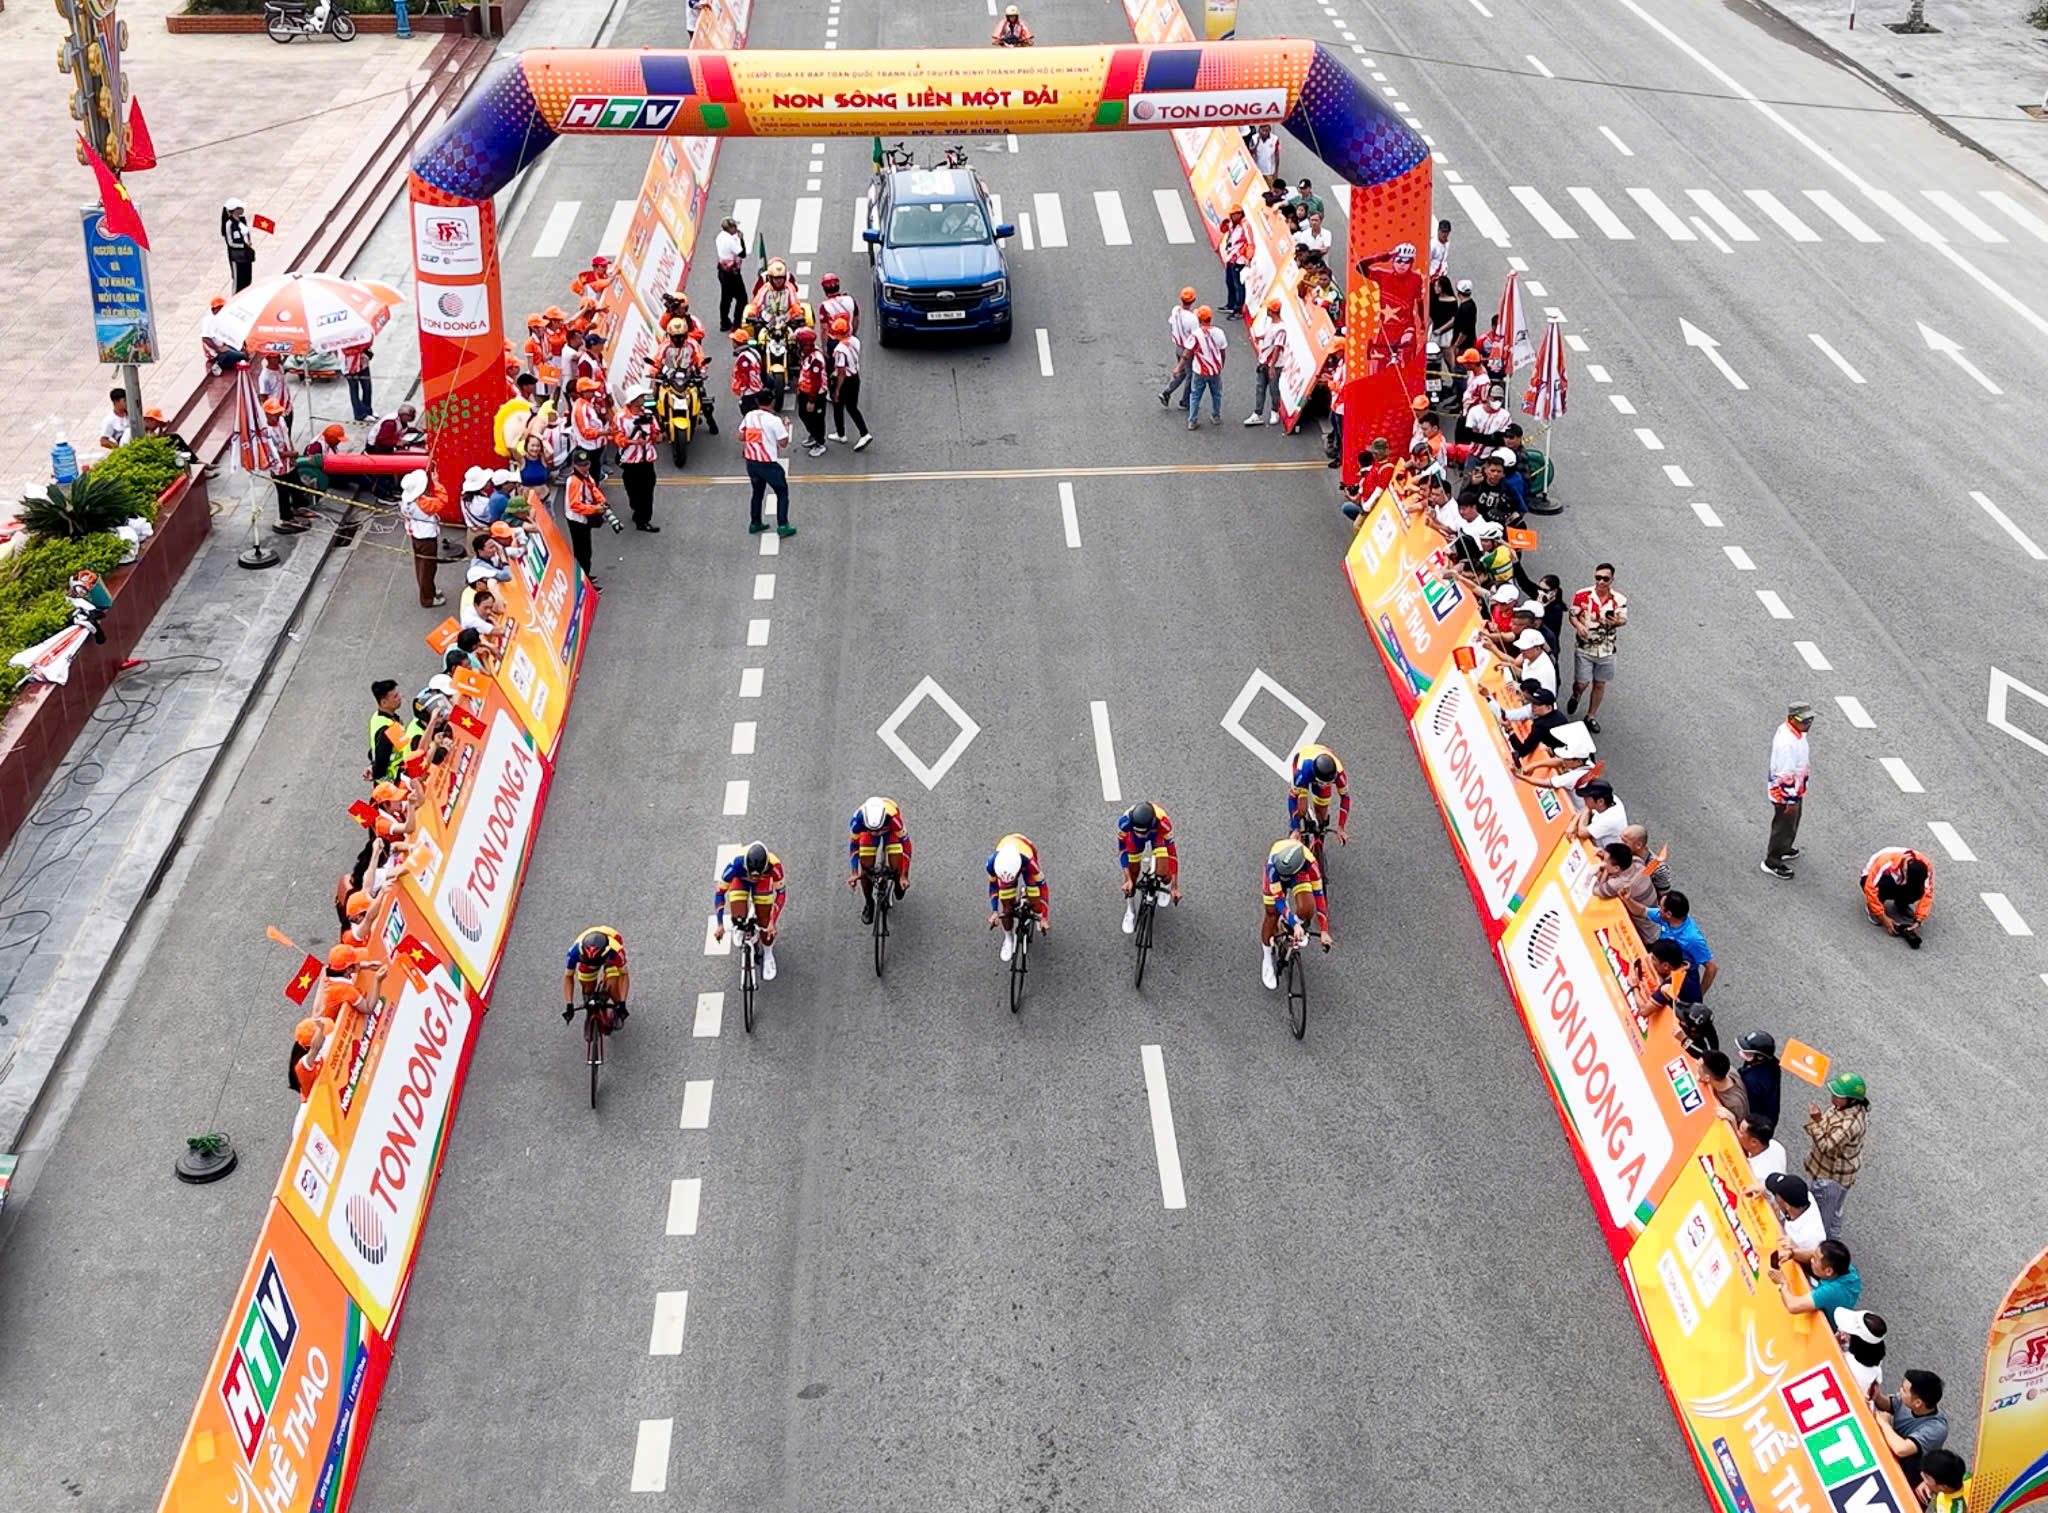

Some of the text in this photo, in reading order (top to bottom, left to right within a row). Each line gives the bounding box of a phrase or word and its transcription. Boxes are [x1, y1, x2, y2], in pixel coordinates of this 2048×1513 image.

[564, 101, 677, 127] HTV
[773, 84, 1058, 110] NON SÔNG LIỀN MỘT DẢI
[1158, 102, 1282, 118] TON DONG A
[423, 318, 487, 331] TON DONG A
[548, 567, 569, 616] THAO
[1405, 606, 1432, 654] THAO
[466, 741, 533, 908] TON DONG A
[1444, 721, 1477, 793] TON
[1464, 774, 1510, 870] DONG
[1496, 859, 1518, 899] A
[370, 981, 459, 1214] TON DONG A
[1543, 955, 1586, 1050] TON
[1571, 1034, 1634, 1160] DONG
[1617, 1153, 1648, 1200] A
[1668, 1059, 1702, 1112] HTV
[224, 1264, 294, 1456] HTV
[283, 1346, 330, 1459] THAO
[1789, 1369, 1893, 1513] HTV
